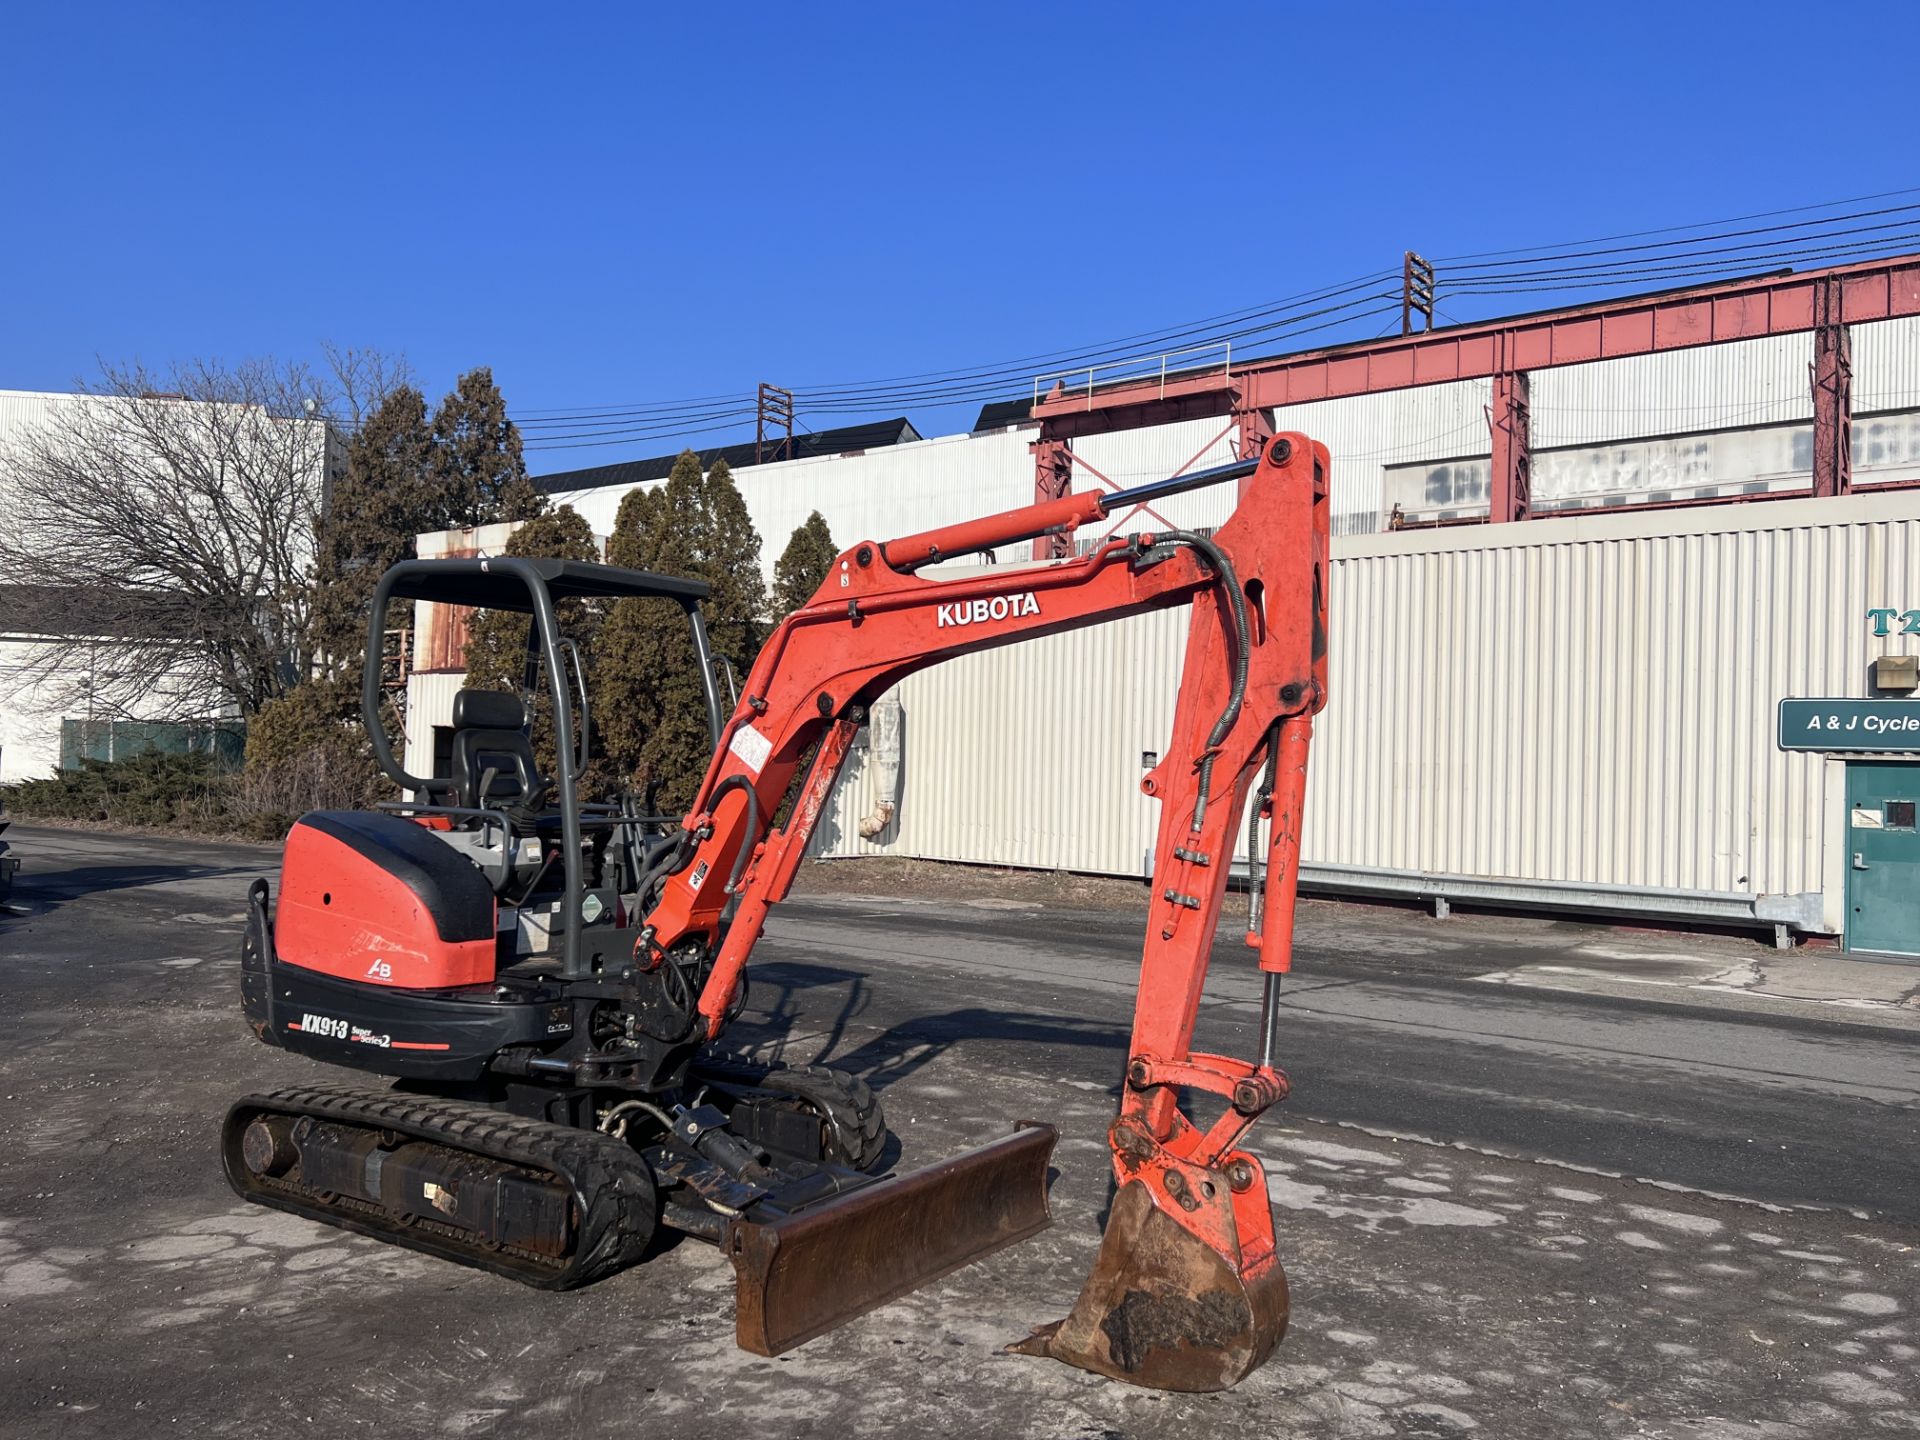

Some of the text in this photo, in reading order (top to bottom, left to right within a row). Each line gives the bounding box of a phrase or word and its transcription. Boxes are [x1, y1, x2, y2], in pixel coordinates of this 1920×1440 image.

[937, 592, 1040, 628] KUBOTA
[1806, 715, 1920, 734] A & J Cycle
[301, 1013, 349, 1040] KX91-3
[351, 1026, 372, 1036] Super
